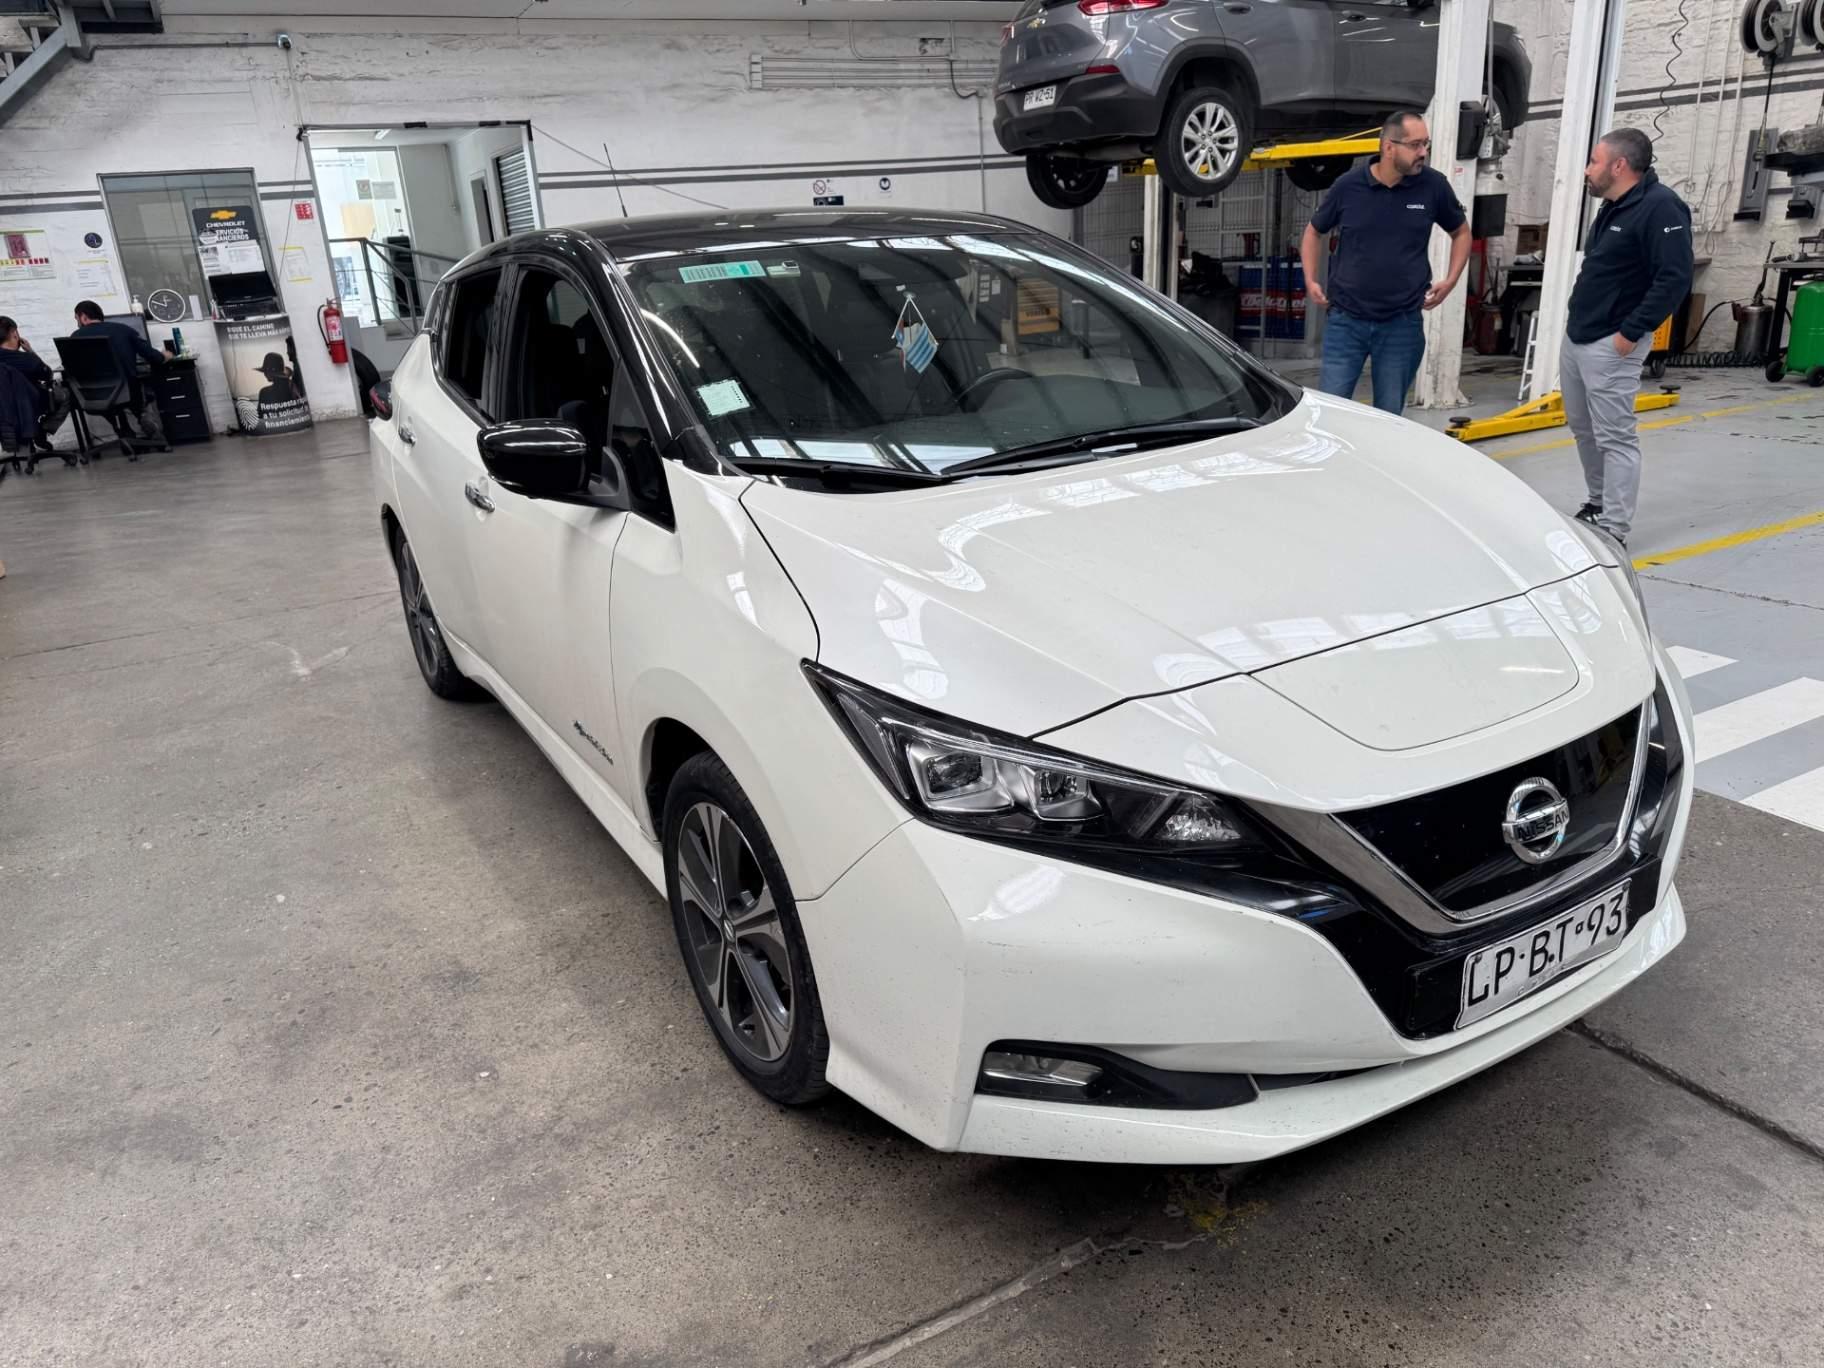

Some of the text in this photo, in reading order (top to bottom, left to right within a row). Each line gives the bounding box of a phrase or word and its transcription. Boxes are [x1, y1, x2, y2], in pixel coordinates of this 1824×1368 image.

[206, 220, 245, 228] CHEVROLET
[260, 399, 297, 411] Respuesta
[1518, 810, 1569, 841] NISSAN
